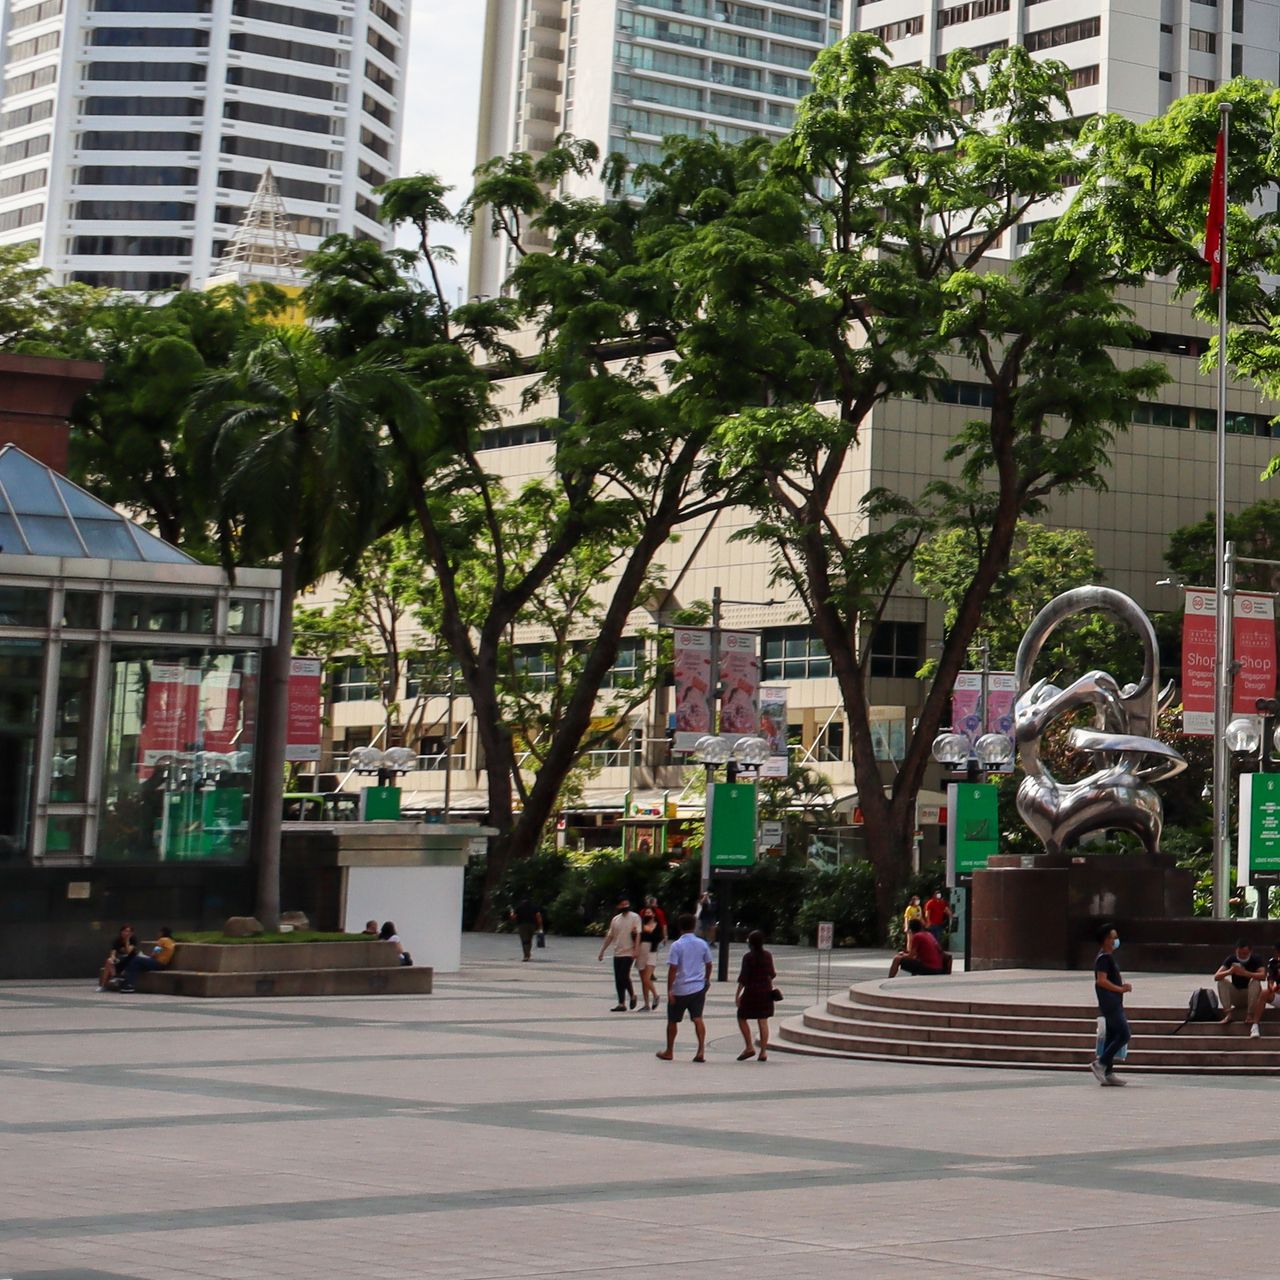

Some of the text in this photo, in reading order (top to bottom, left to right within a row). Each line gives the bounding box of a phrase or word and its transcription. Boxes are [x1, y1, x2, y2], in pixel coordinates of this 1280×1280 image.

[1187, 652, 1217, 669] Shop
[1240, 655, 1271, 671] Shop
[1244, 681, 1266, 690] Design
